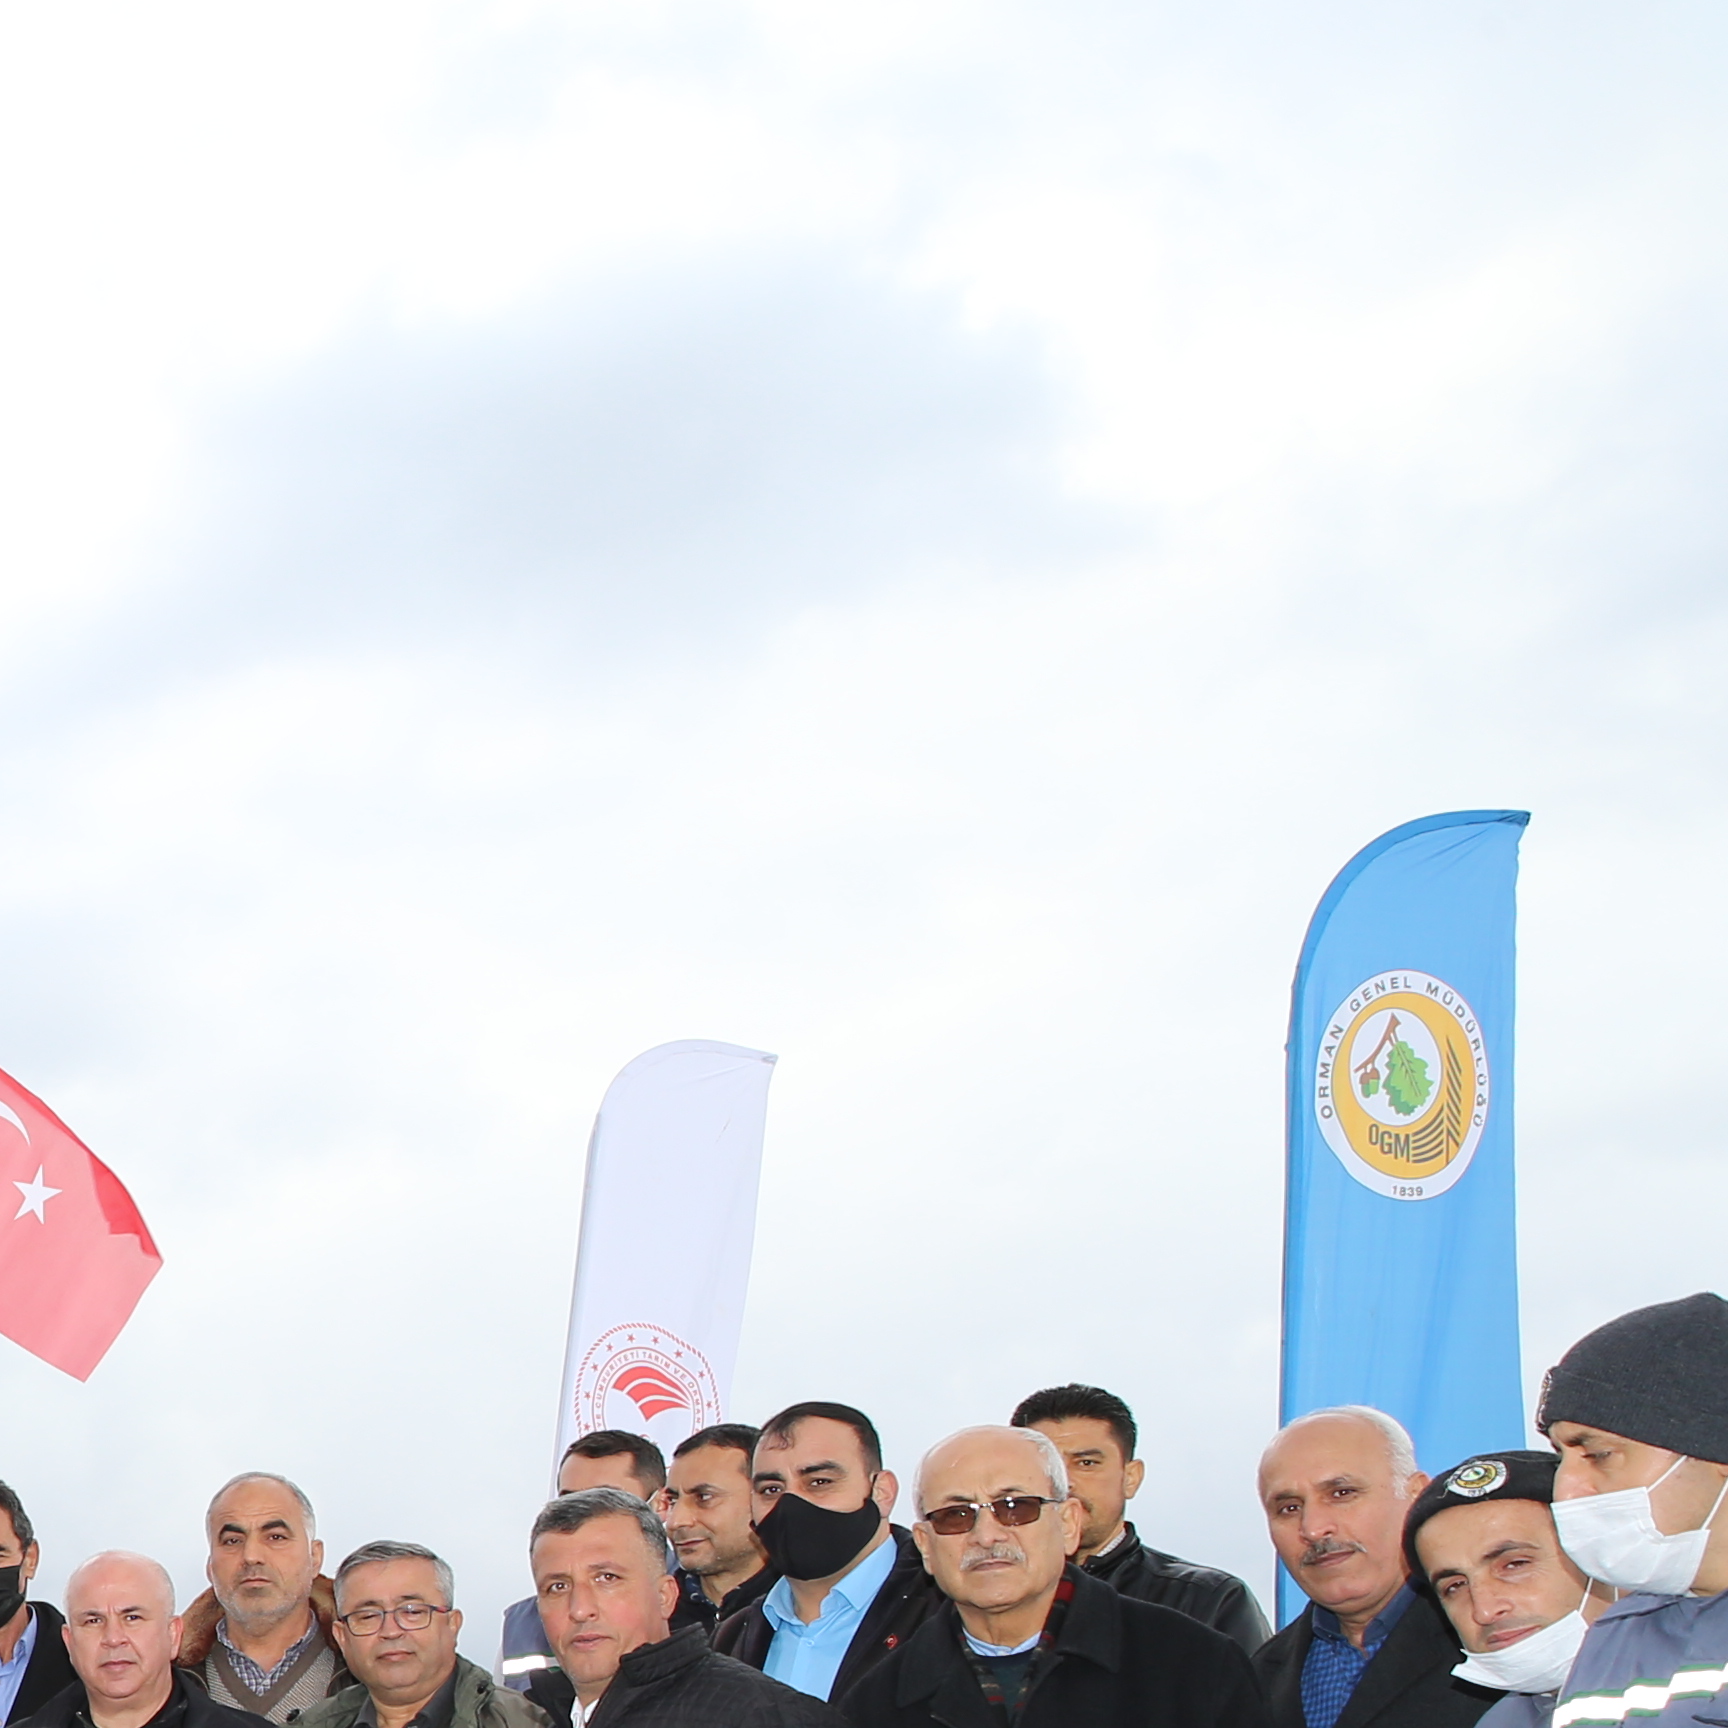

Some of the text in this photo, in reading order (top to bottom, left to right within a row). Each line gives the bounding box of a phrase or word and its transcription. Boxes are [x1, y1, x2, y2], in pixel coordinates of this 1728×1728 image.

[1318, 976, 1487, 1127] ORMAN GENEL MÜDÜRLÜĞÜ
[1368, 1123, 1411, 1163] OGM
[1392, 1185, 1423, 1197] 1839
[642, 1351, 671, 1370] TARIM
[674, 1368, 687, 1381] VE
